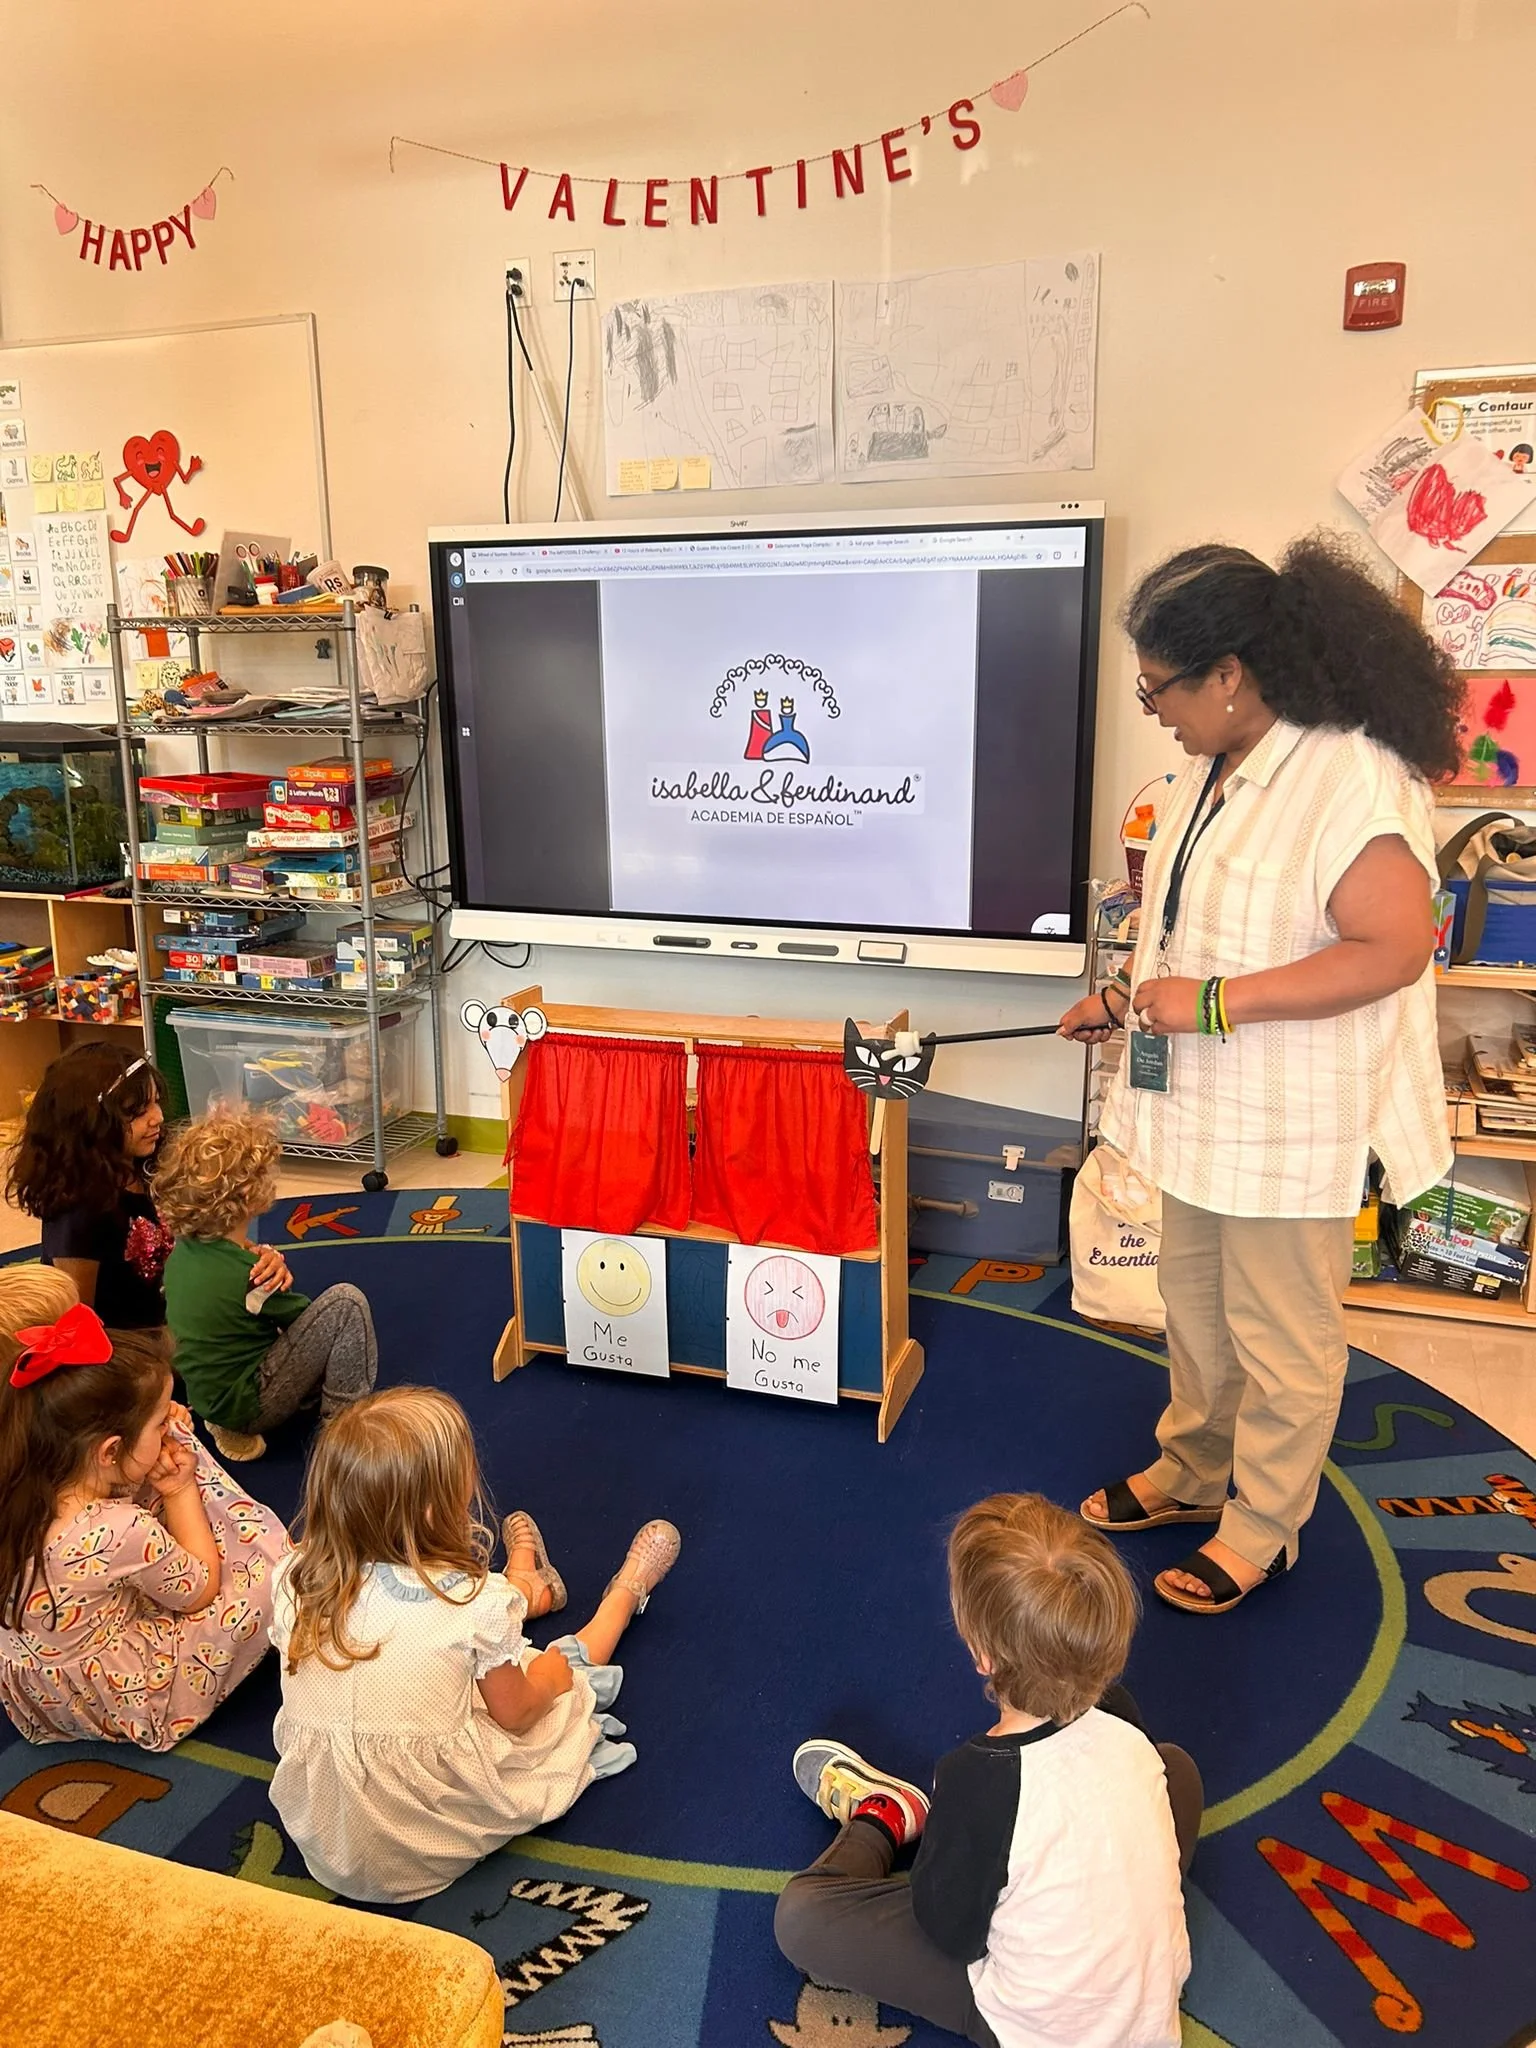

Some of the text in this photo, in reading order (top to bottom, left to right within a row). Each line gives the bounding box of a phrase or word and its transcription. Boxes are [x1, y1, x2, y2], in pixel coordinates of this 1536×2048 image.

[499, 99, 982, 228] VALENTINE'S
[79, 204, 196, 271] HAPPY
[1358, 297, 1389, 308] FIRE
[1478, 401, 1534, 413] Centaur
[651, 769, 749, 802] isabella
[751, 769, 777, 804] &
[282, 811, 310, 823] Spelling
[691, 810, 763, 824] ACADEMIA
[767, 811, 785, 824] DE
[1120, 1234, 1147, 1248] the
[593, 1321, 628, 1347] Me
[583, 1346, 633, 1367] Gusta
[752, 1339, 821, 1373] No me
[755, 1369, 804, 1393] Gusta
